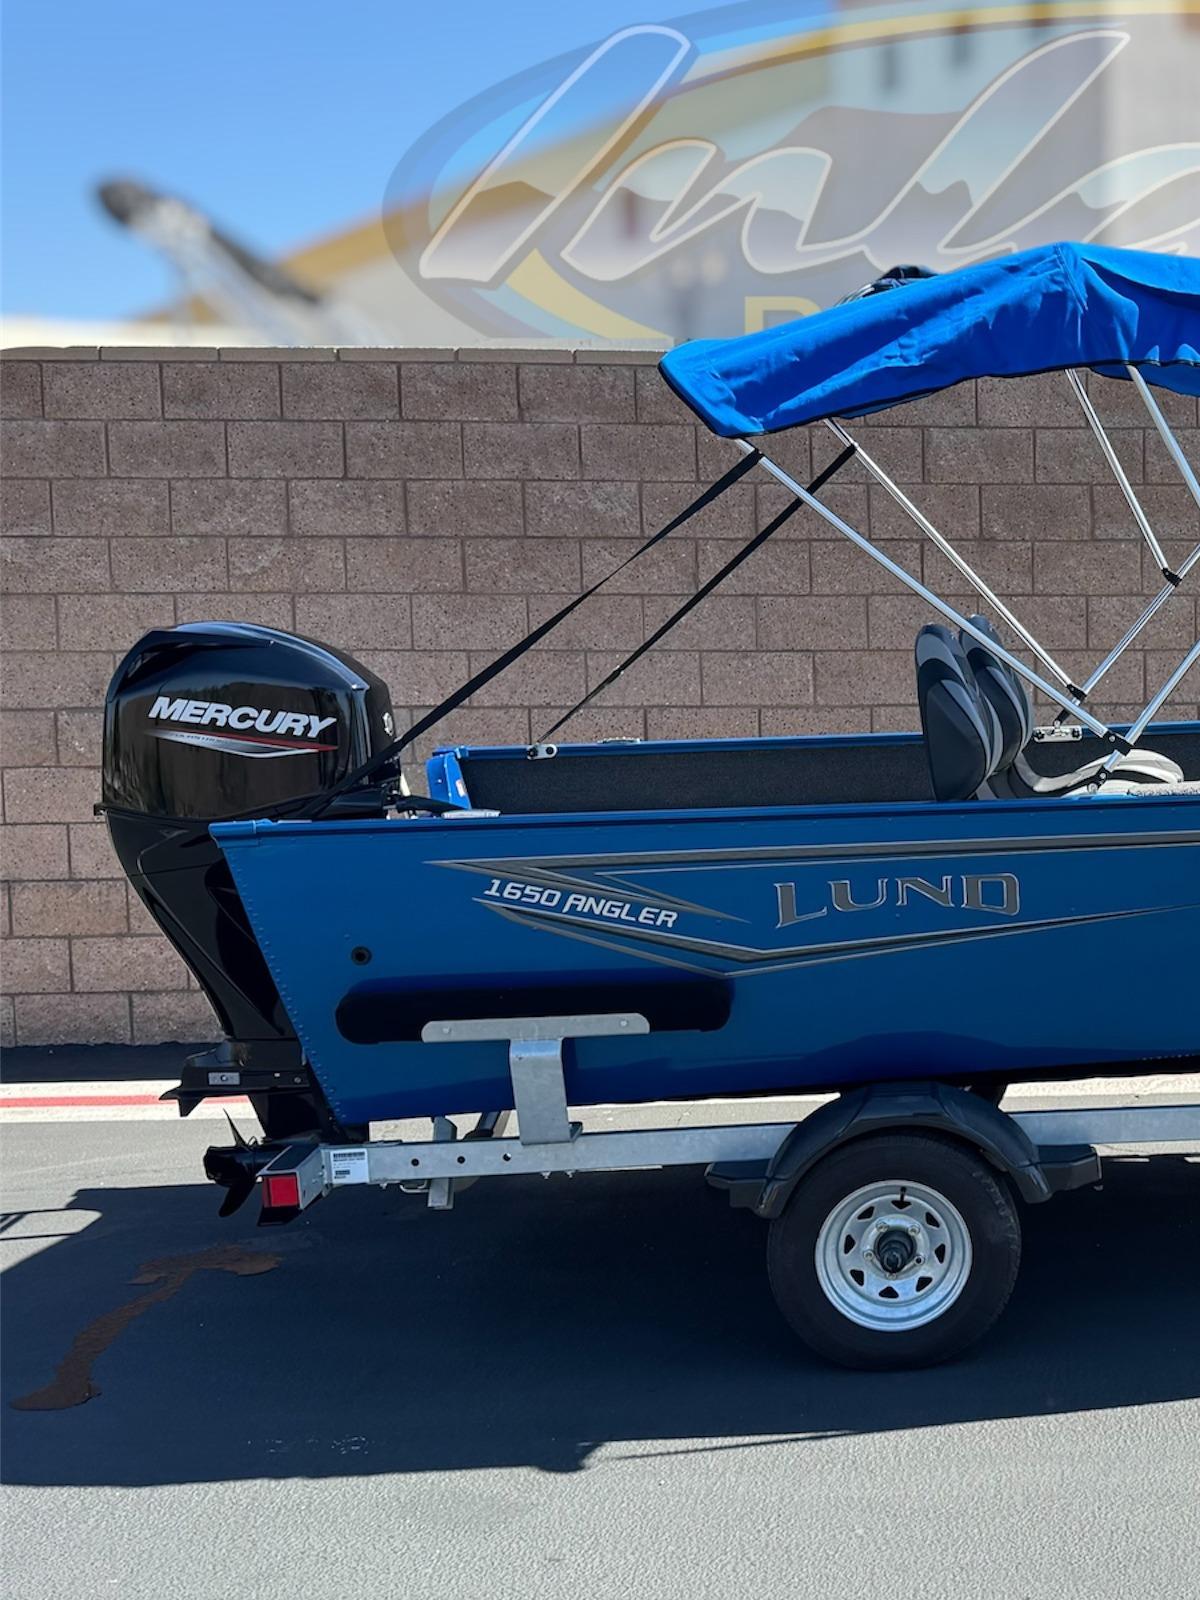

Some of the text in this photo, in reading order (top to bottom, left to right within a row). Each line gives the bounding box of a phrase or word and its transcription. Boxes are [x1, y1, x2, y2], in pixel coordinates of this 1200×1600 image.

[148, 696, 337, 738] MERCURY
[484, 879, 679, 928] 1650 ANGLER
[773, 873, 1021, 929] LUND
